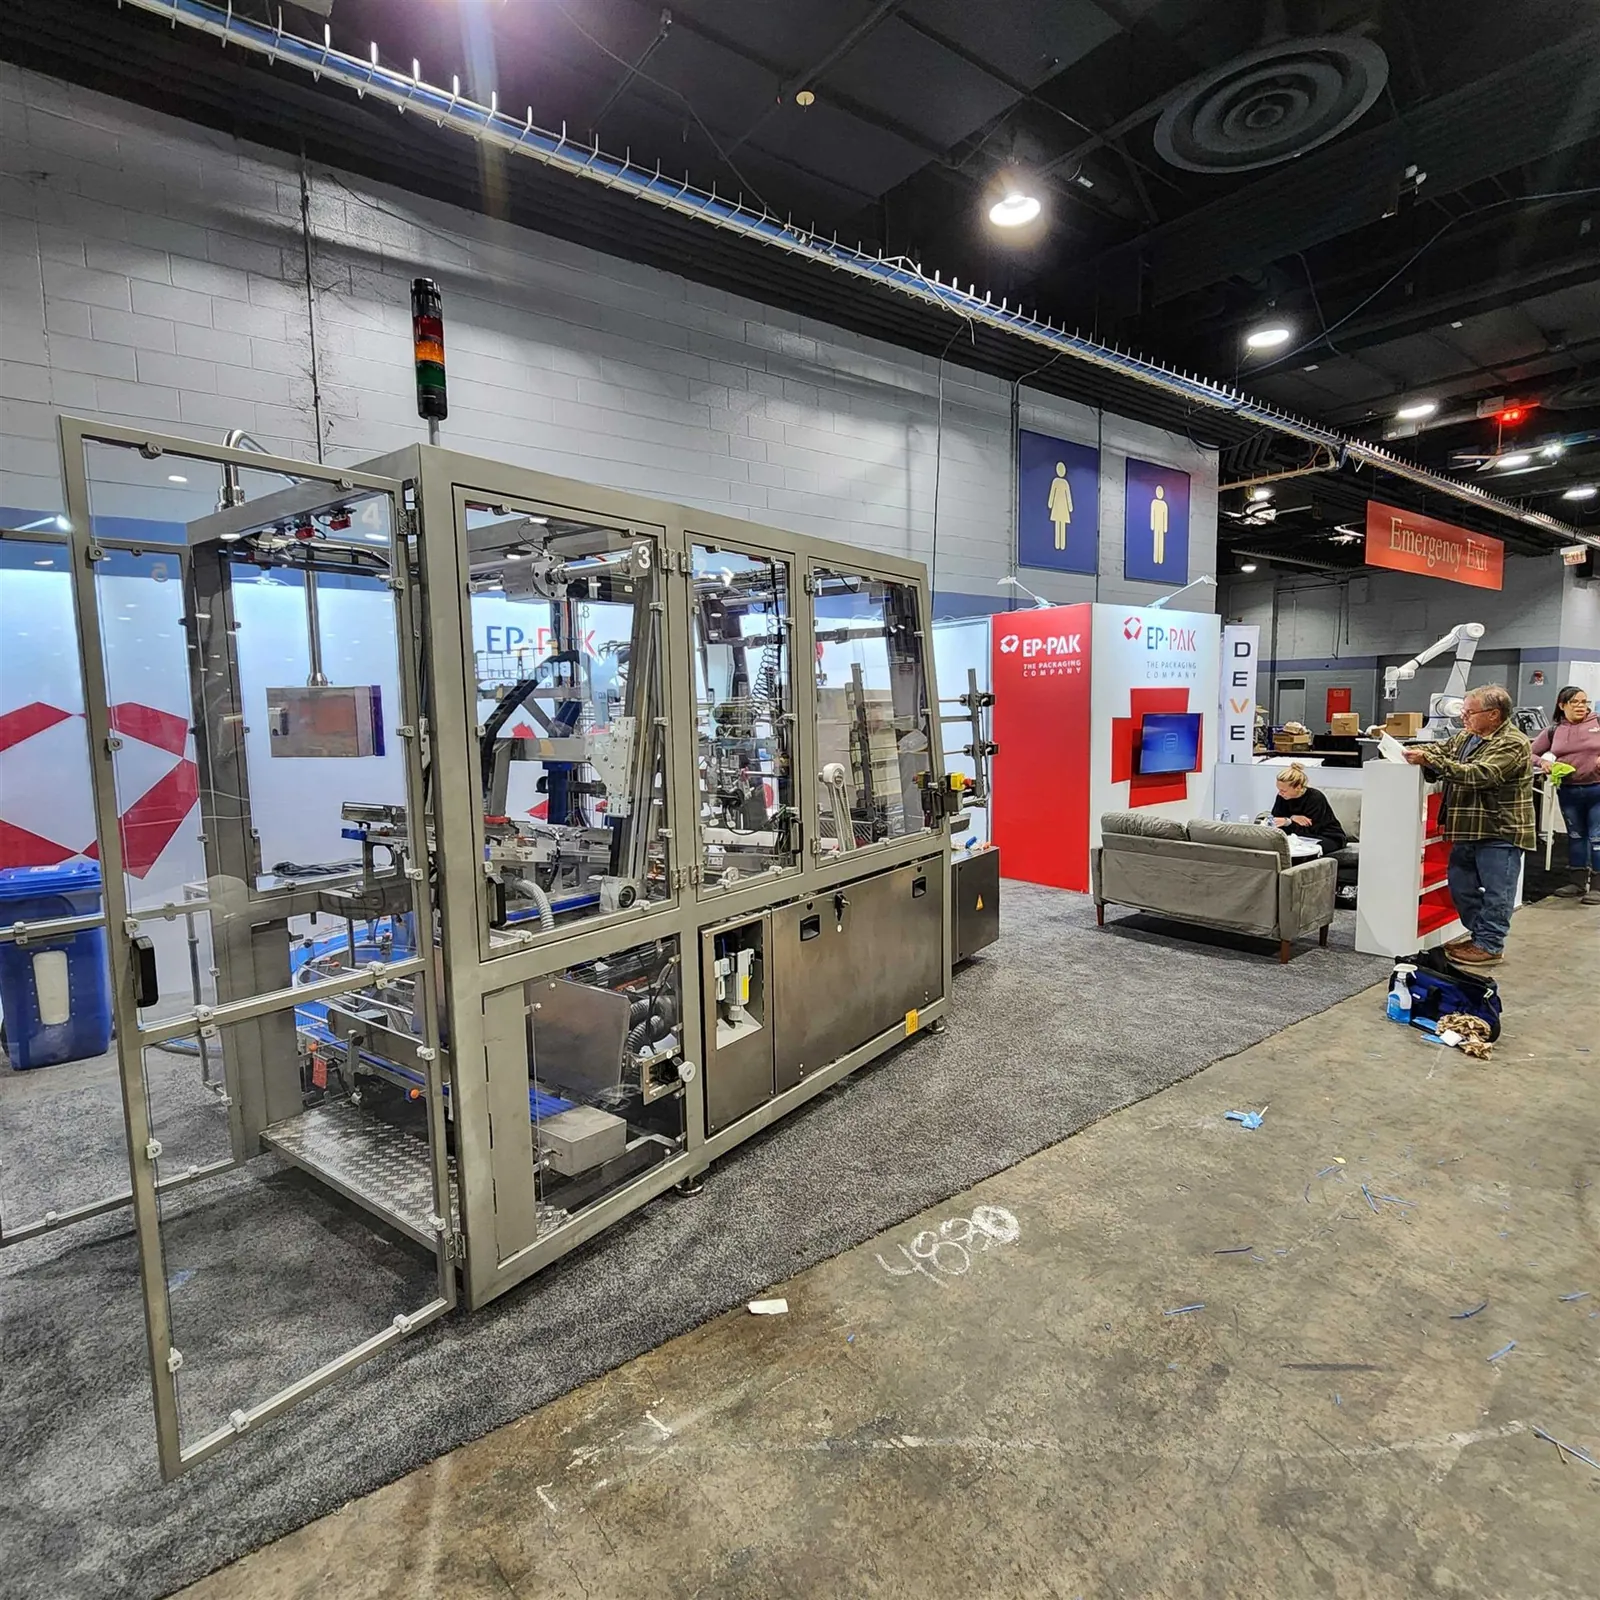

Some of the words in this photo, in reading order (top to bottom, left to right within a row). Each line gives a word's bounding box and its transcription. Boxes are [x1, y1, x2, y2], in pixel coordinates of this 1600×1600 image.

[362, 502, 381, 530] 4
[1389, 516, 1463, 573] Emergency
[1466, 538, 1489, 572] Exit
[638, 545, 650, 569] 3
[1564, 551, 1584, 563] EXIT
[1023, 662, 1036, 670] THE
[1038, 659, 1081, 669] PACKAGING
[1146, 661, 1158, 669] THE
[1161, 661, 1197, 670] PACKAGING
[1023, 667, 1081, 677] COMPANY
[1146, 671, 1197, 679] COMPANY
